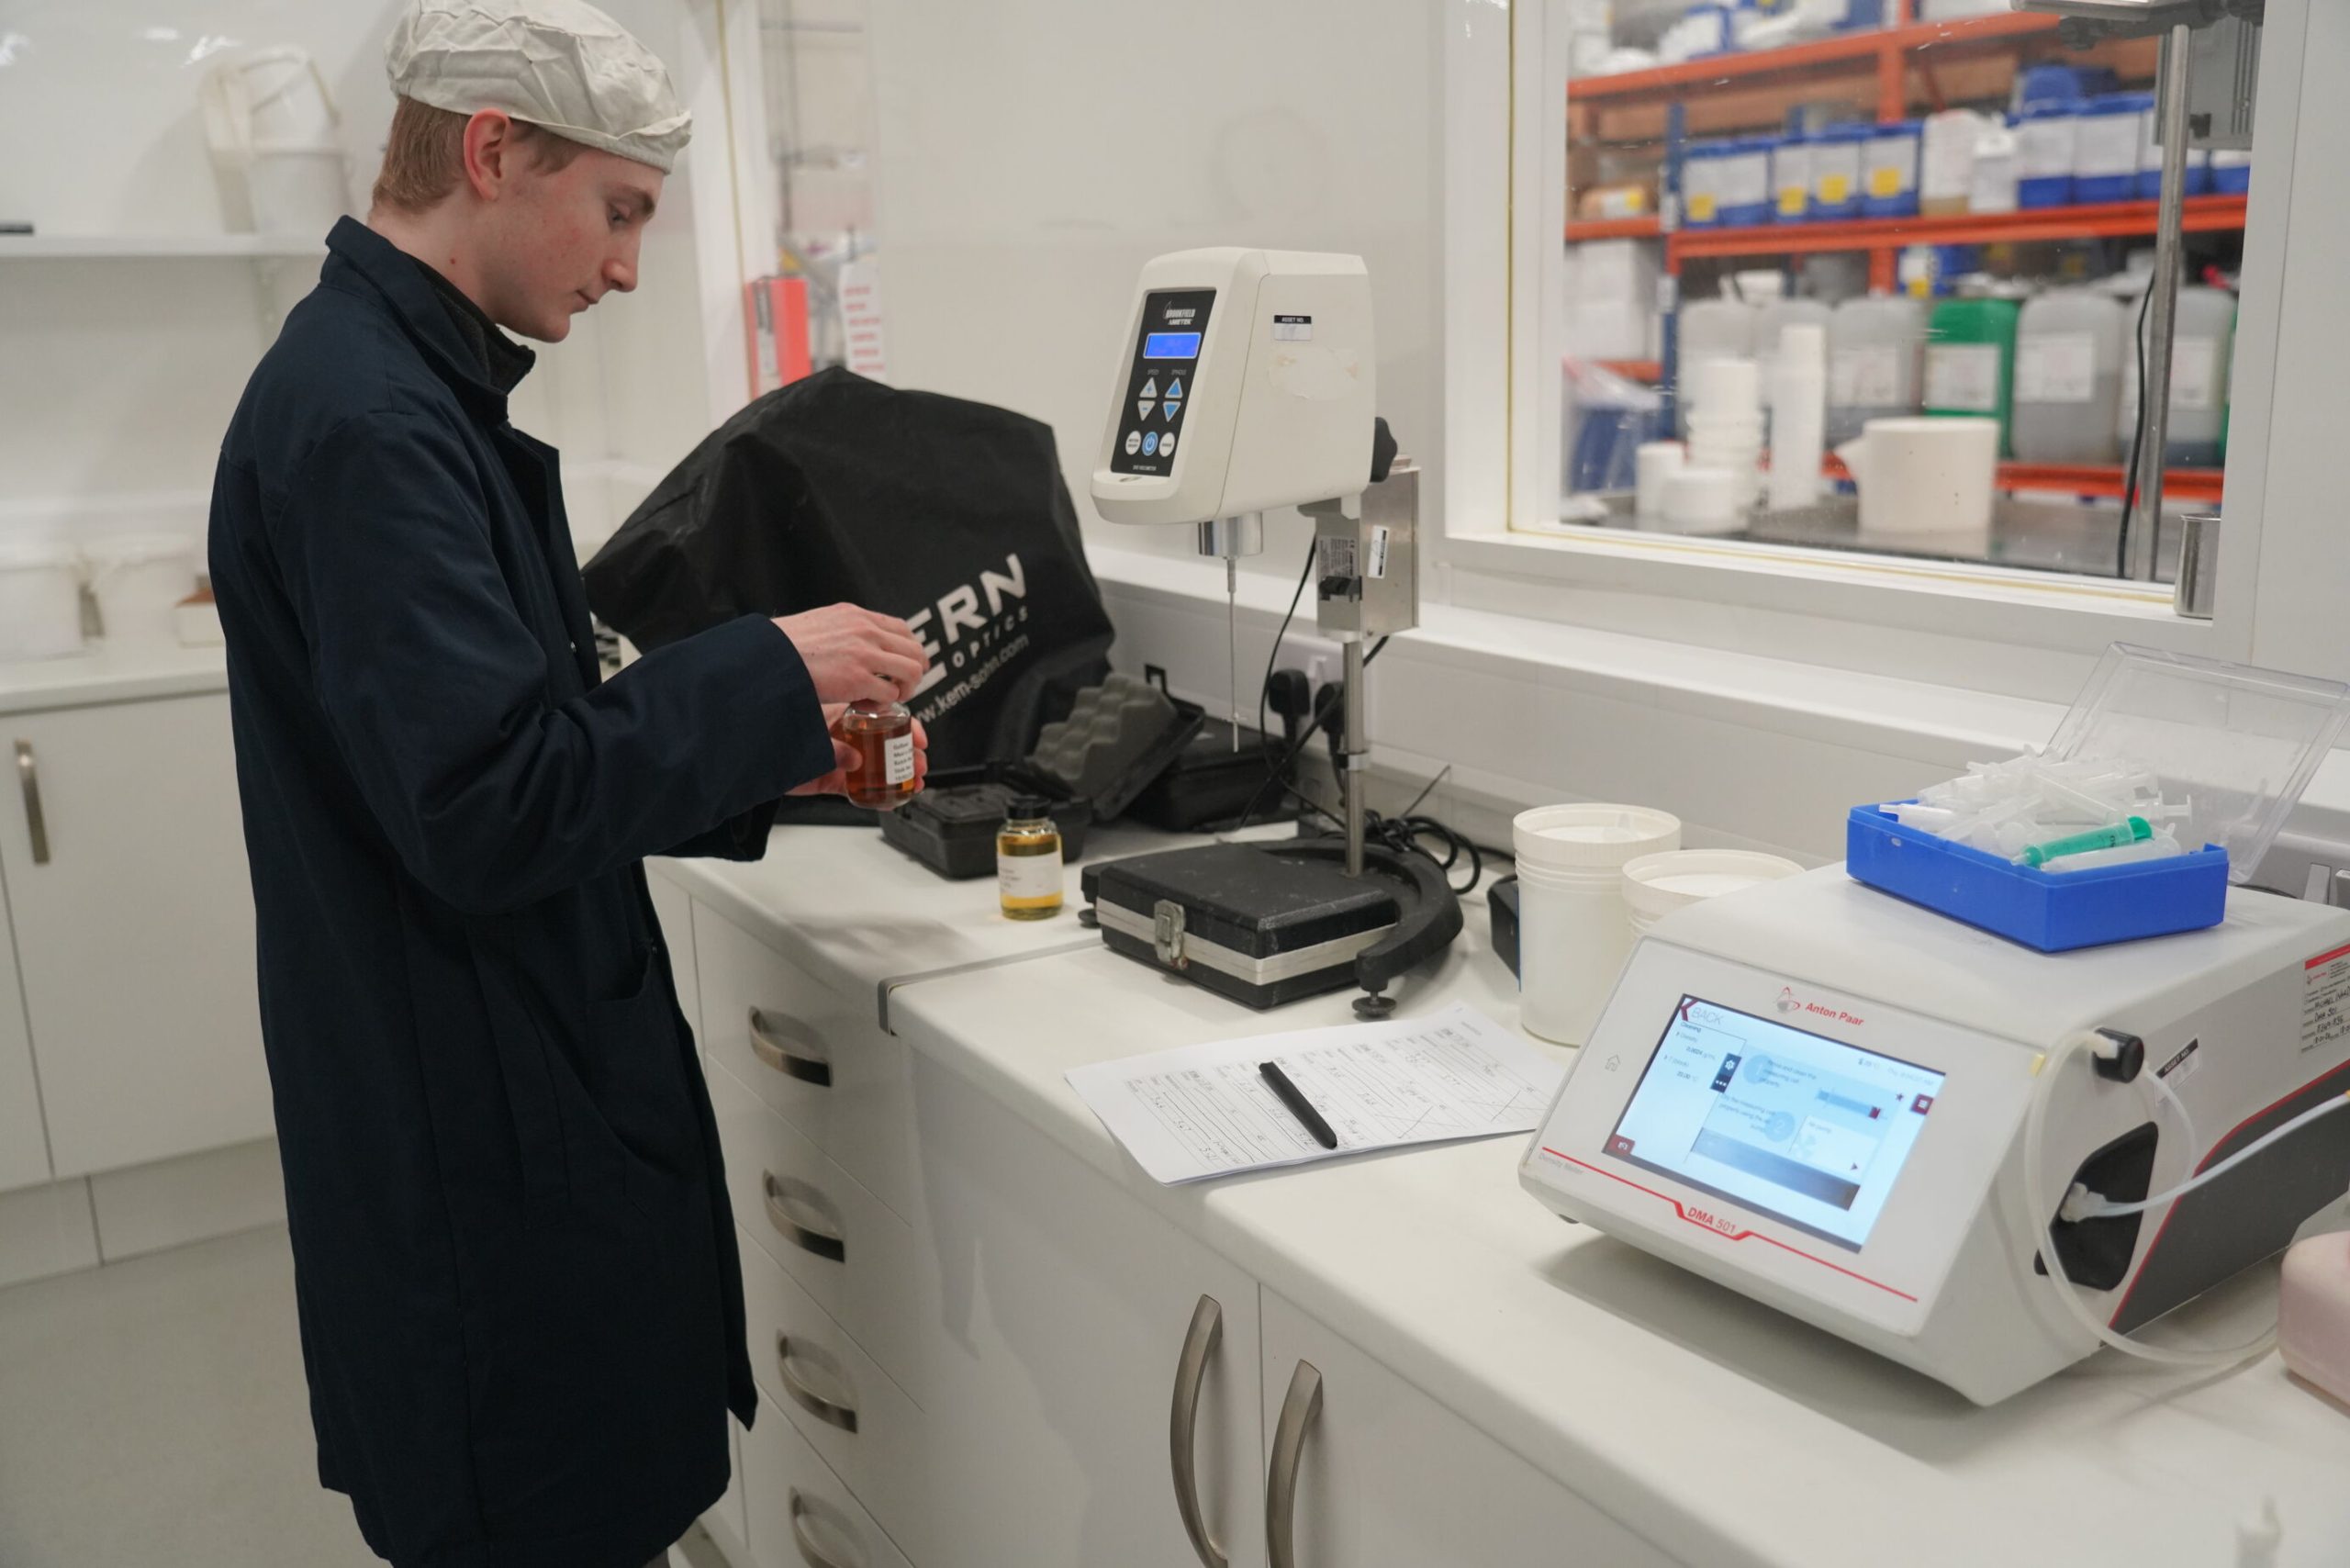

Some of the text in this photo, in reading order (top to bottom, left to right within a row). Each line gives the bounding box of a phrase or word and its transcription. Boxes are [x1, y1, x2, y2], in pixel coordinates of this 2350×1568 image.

[1166, 308, 1196, 318] BROOKFIELD
[952, 605, 1029, 668] OPTICS
[1691, 1006, 1724, 1025] BACK
[1806, 1002, 1864, 1025] Anton Paar
[1539, 1152, 1562, 1168] Density
[1687, 1206, 1736, 1234] DMA 501
